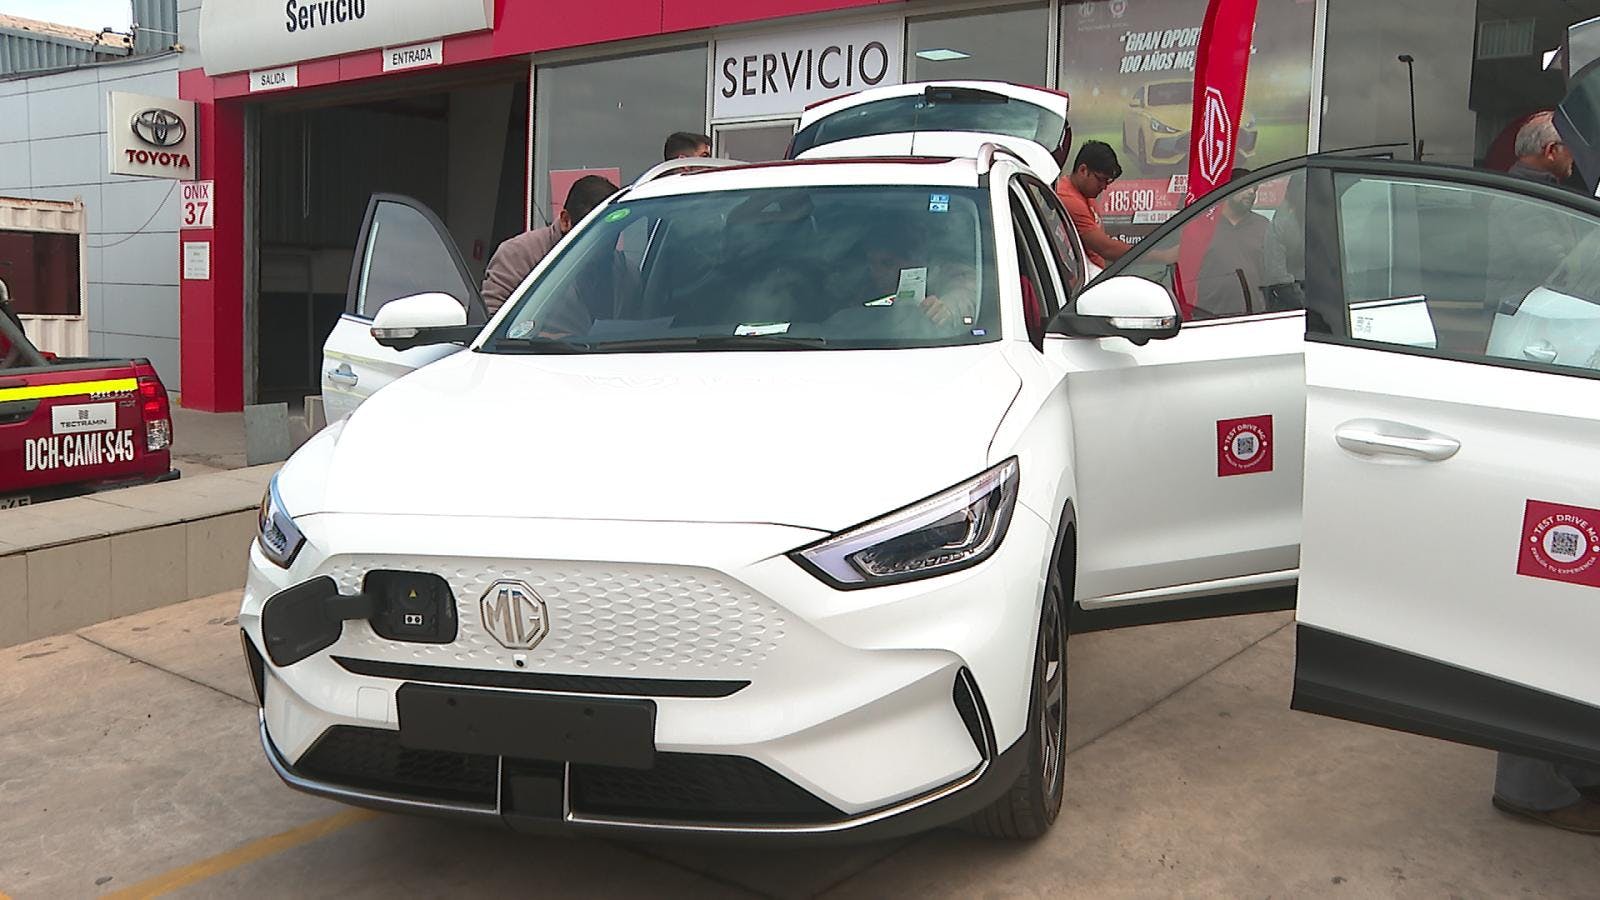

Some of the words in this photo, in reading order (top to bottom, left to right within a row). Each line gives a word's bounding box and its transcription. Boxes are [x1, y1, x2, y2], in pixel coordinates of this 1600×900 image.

[286, 0, 365, 33] Servicio
[392, 48, 432, 66] ENTRADA
[1119, 56, 1143, 74] 100
[1141, 51, 1176, 72] AÑOS
[261, 72, 286, 86] SALIDA
[721, 41, 889, 98] SERVICIO
[125, 149, 191, 168] TOYOTA
[183, 185, 209, 199] ONIX
[184, 201, 208, 225] 37
[60, 419, 107, 429] TECTRAMIN
[1225, 428, 1237, 444] TEST
[1237, 424, 1258, 432] DRIVE
[25, 429, 134, 471] DCH-CAMI-S45
[1533, 516, 1554, 534] TEST
[1556, 514, 1588, 528] DRIVE
[1586, 527, 1599, 542] MG
[485, 586, 542, 644] MG
